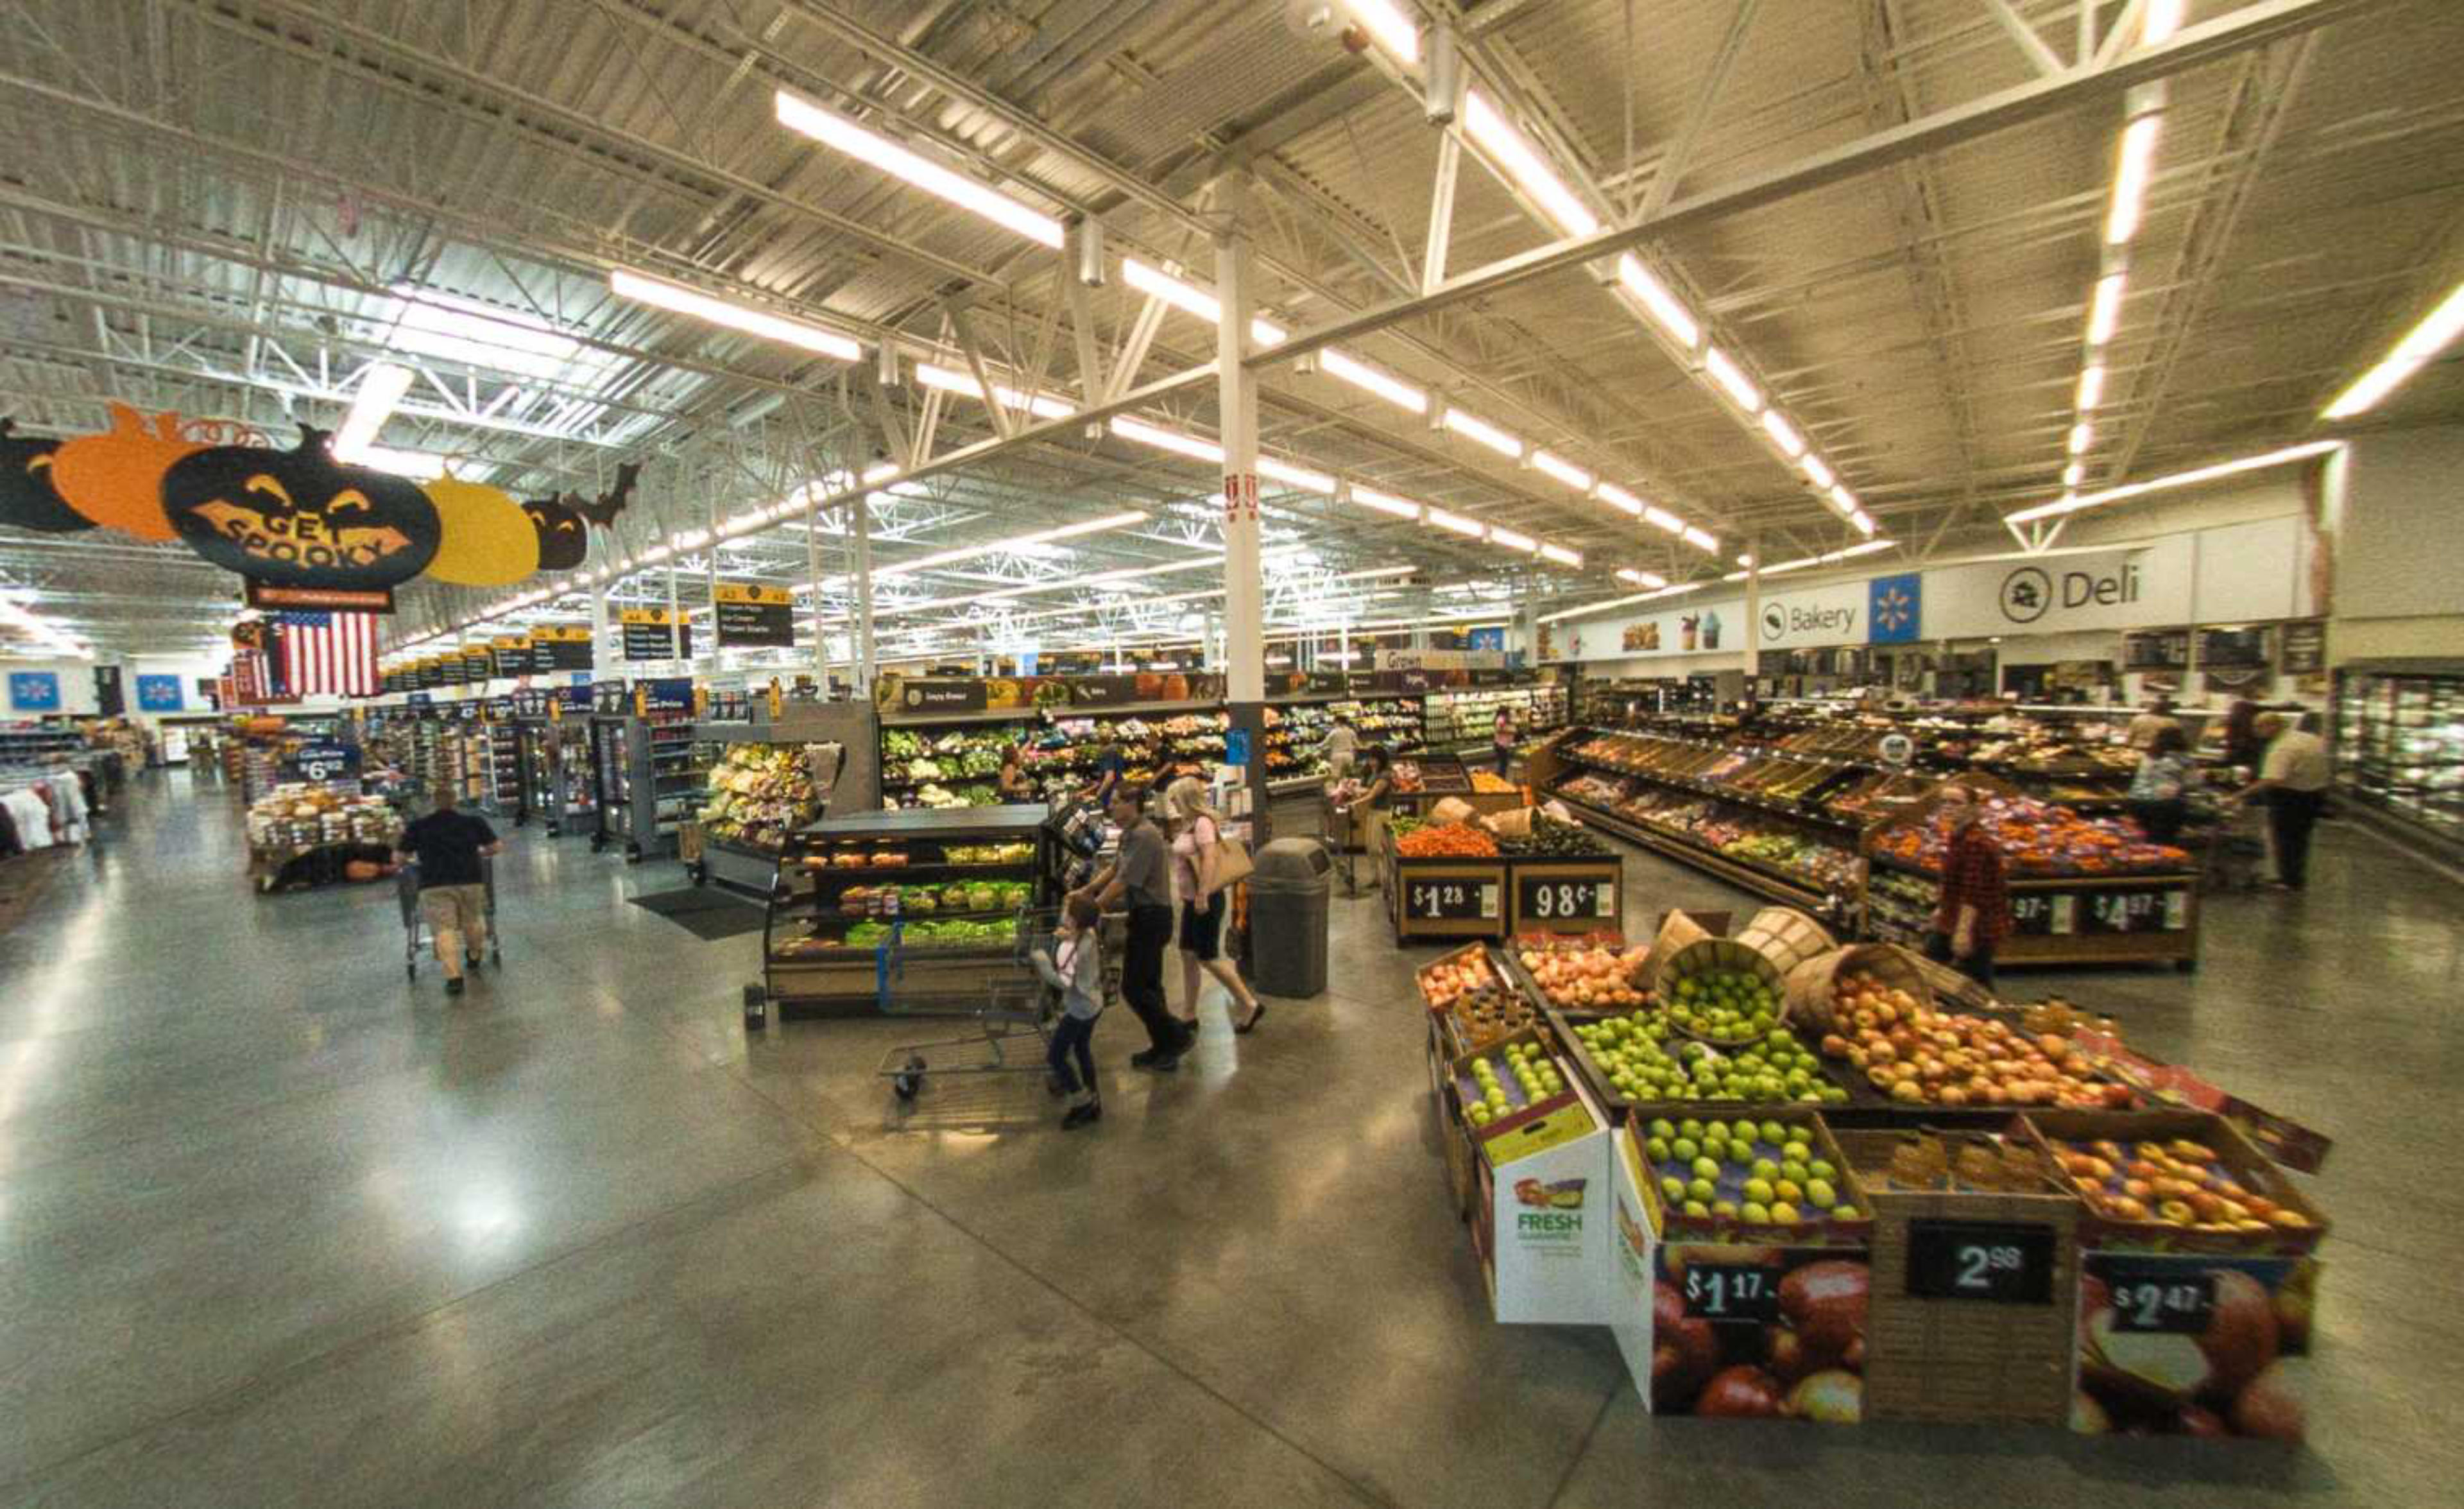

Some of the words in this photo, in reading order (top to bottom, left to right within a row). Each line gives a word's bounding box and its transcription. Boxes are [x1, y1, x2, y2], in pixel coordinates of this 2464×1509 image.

[226, 519, 383, 567] SPOOKY
[263, 514, 343, 545] GET
[2063, 564, 2139, 608] Deli
[1790, 603, 1856, 634] Bakery
[1518, 1213, 1583, 1231] FRESH
